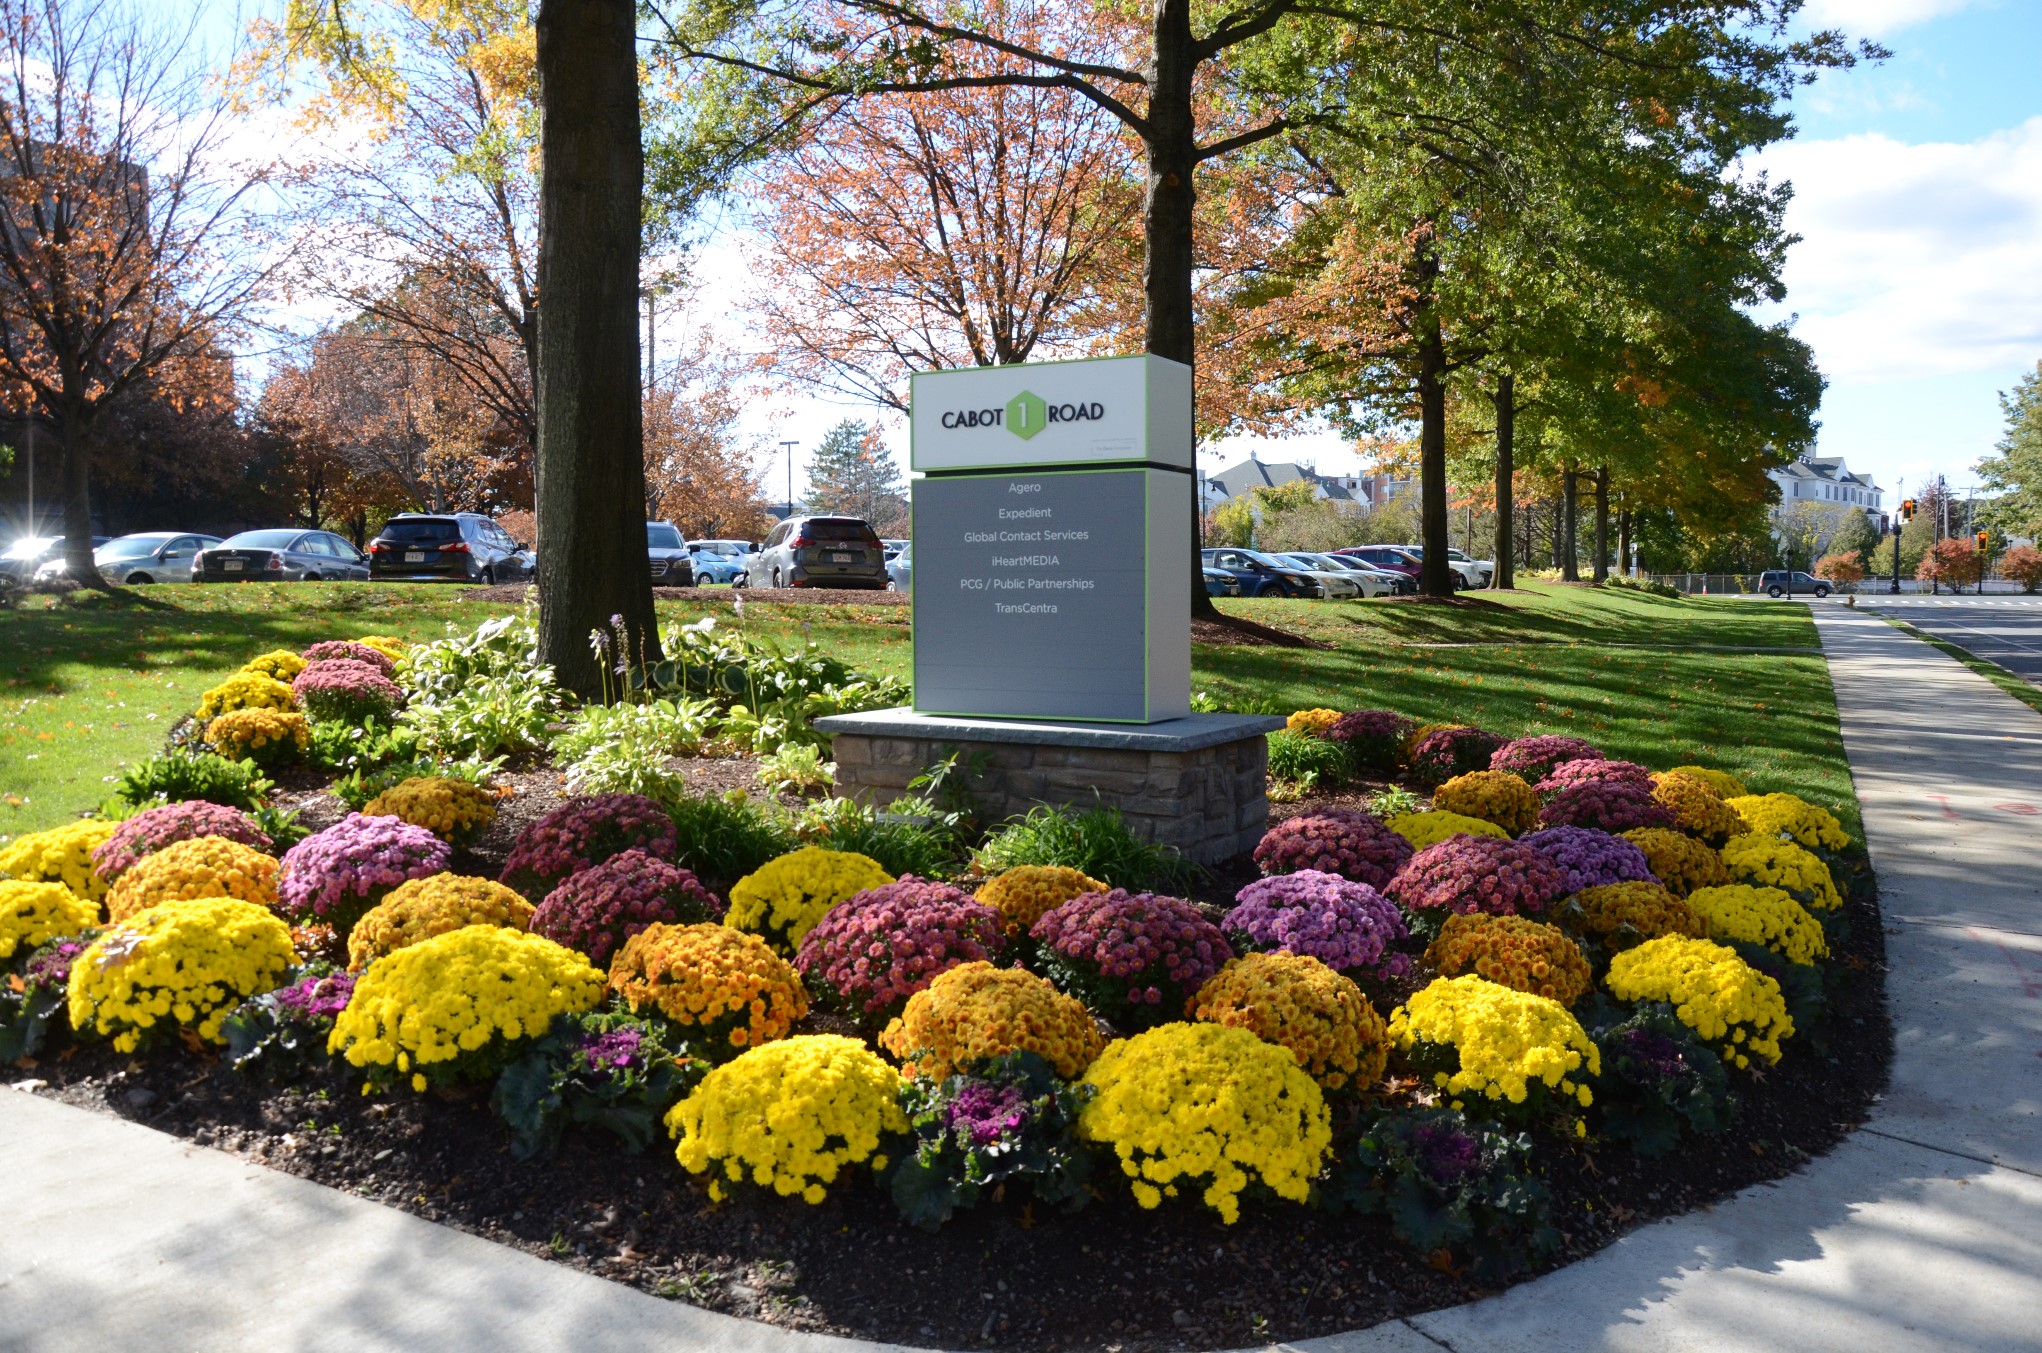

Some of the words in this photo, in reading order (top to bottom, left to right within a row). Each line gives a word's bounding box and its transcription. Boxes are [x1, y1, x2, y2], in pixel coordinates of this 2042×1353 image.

[941, 408, 1004, 429] CABOT
[1018, 402, 1027, 428] 1
[1048, 402, 1104, 423] ROAD
[1008, 482, 1042, 494] Agero
[998, 507, 1053, 520] Expedient
[964, 531, 997, 542] Global
[999, 531, 1041, 541] Contact
[1043, 530, 1089, 541] Services
[991, 555, 1060, 566] iHeartMEDIA
[960, 579, 983, 590] PCG
[984, 578, 992, 591] /
[993, 578, 1026, 589] Public
[1027, 577, 1095, 591] Partnerships
[994, 602, 1058, 614] TransCentra
